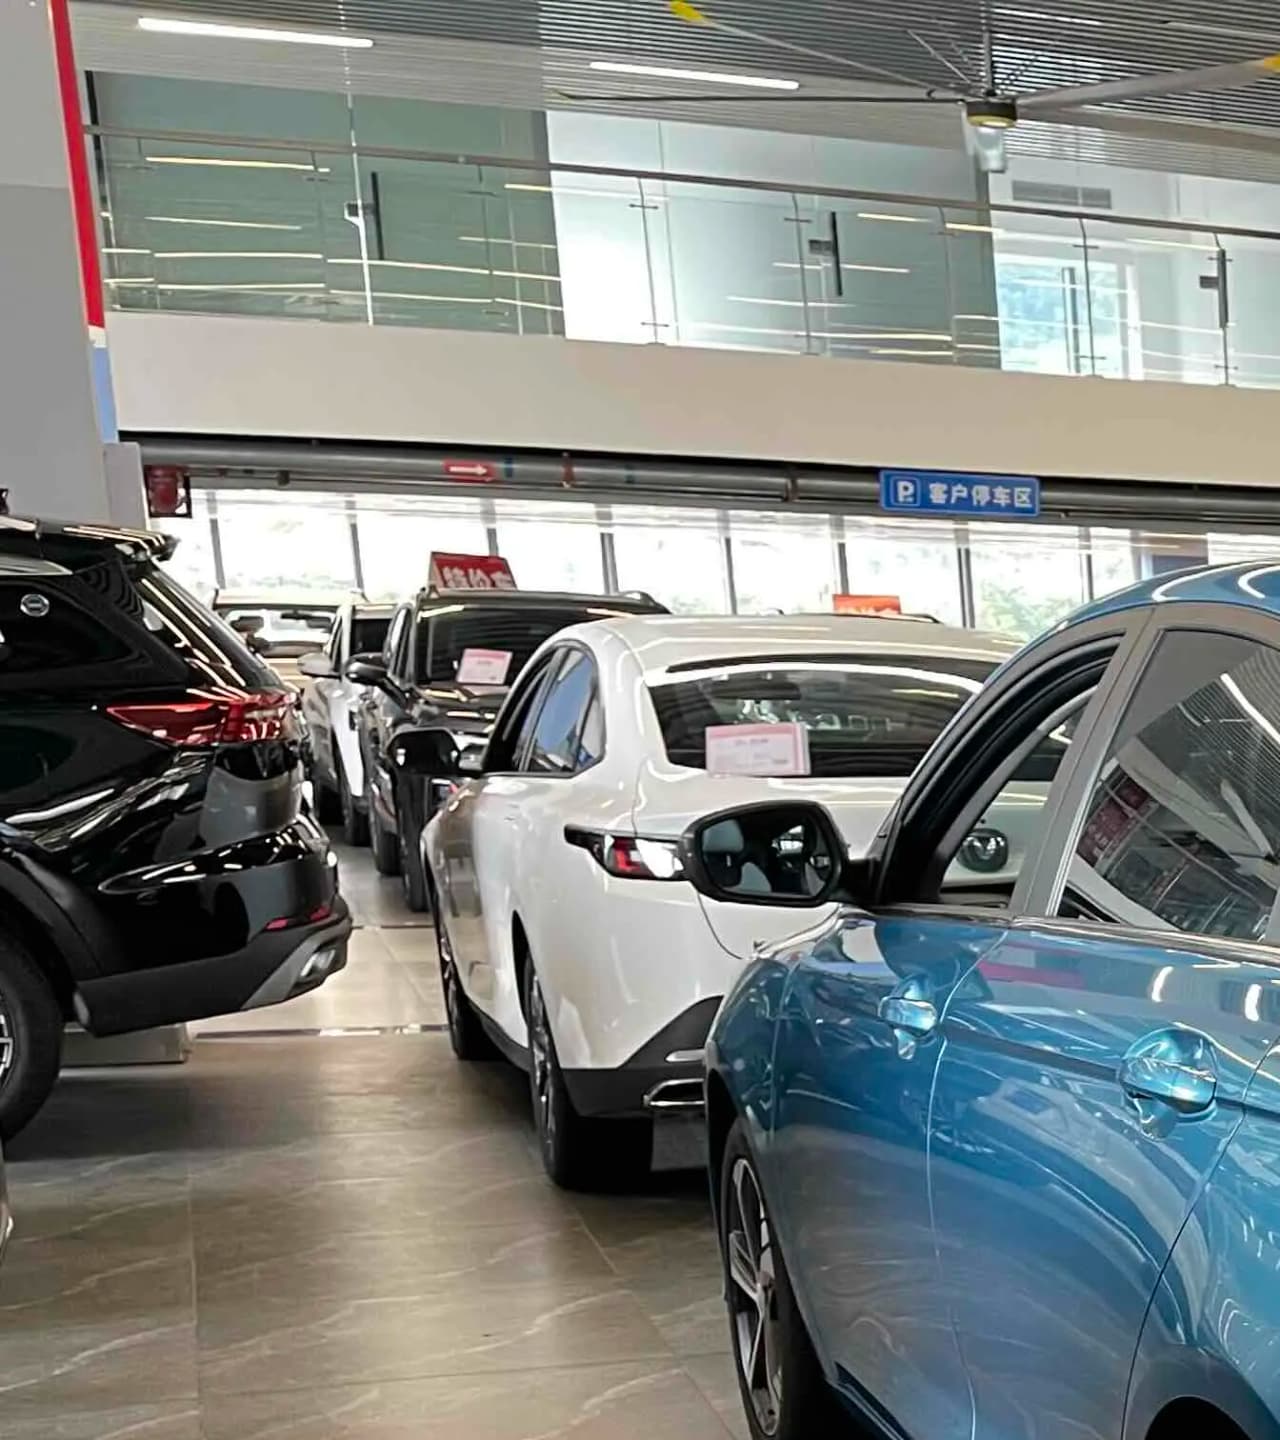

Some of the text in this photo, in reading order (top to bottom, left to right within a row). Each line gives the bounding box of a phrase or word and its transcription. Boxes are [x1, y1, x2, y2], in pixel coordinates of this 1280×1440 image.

[928, 481, 1033, 508] 客户停车区
